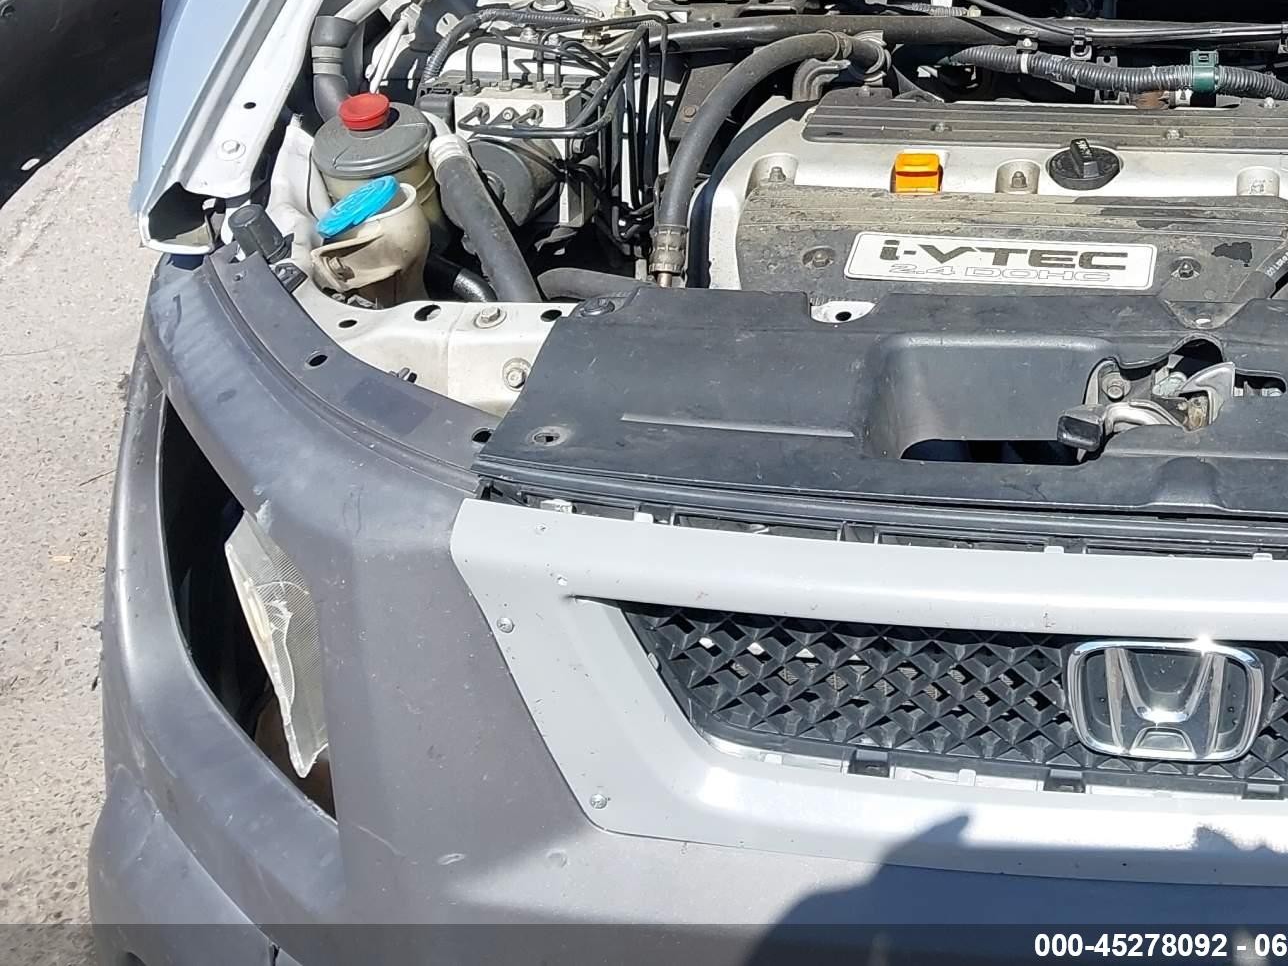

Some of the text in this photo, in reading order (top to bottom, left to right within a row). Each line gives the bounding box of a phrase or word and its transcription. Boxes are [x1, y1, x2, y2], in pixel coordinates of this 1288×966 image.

[880, 239, 1129, 271] i-VTEC
[889, 263, 1111, 282] 2.4 DOHC
